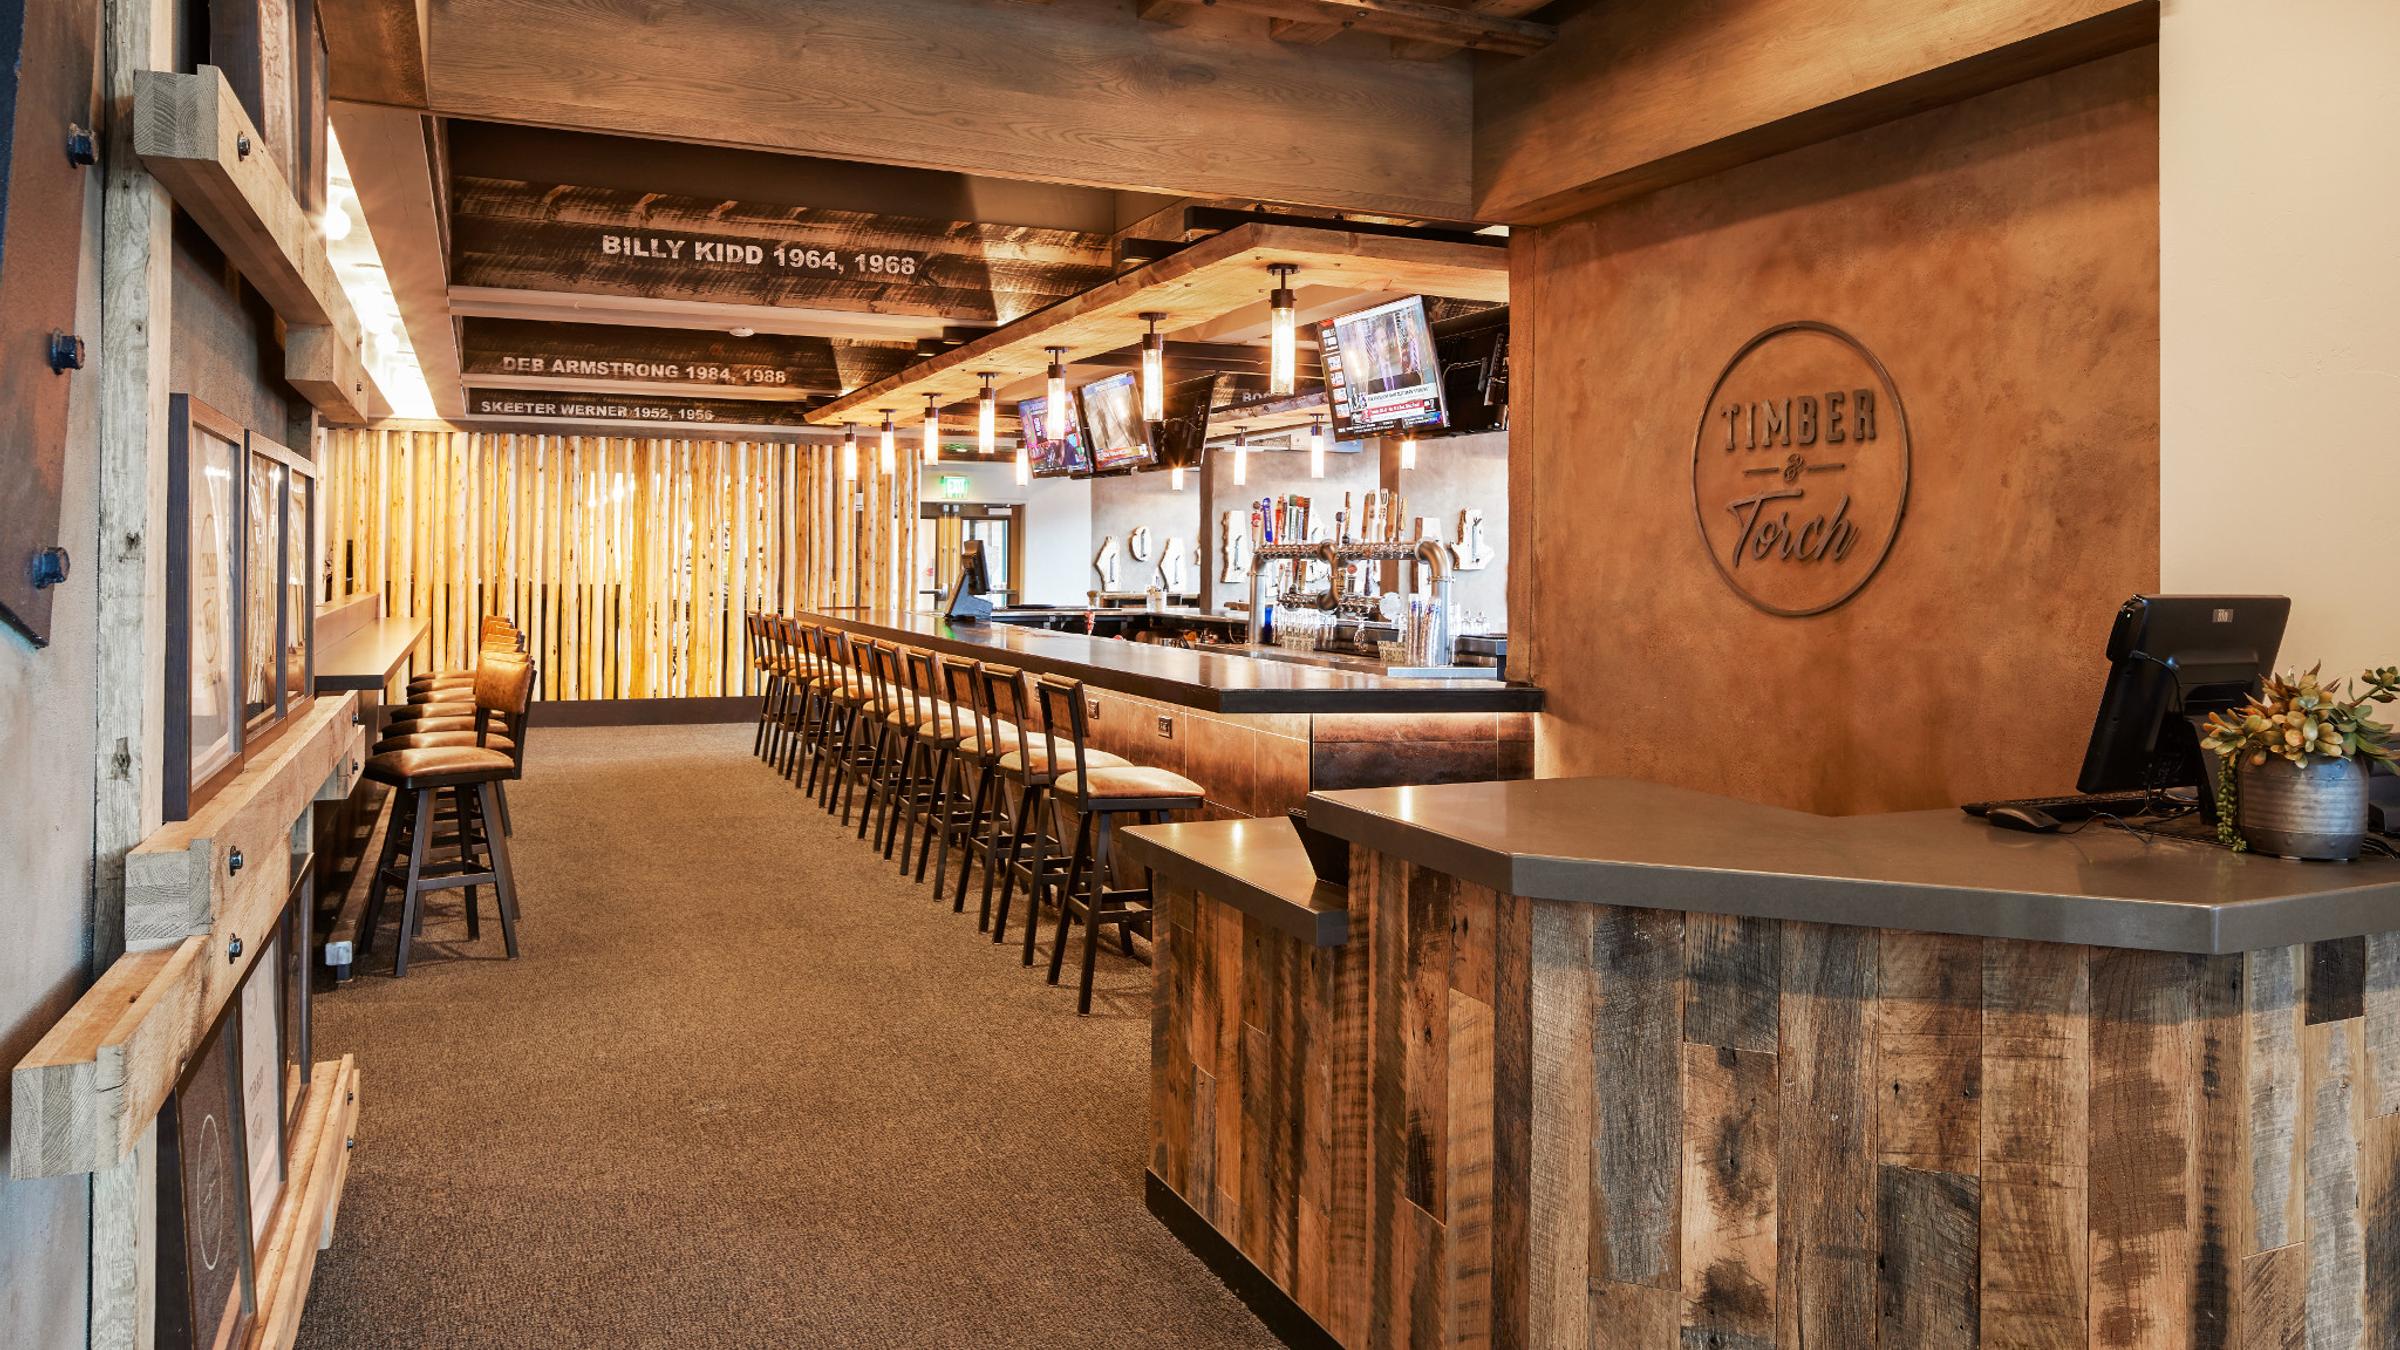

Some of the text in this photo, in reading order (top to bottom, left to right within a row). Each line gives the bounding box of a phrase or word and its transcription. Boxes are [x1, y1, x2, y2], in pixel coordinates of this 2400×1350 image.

[602, 234, 916, 275] BILLY KIDD 1964, 1968
[502, 356, 786, 384] DEB ARMSTRONG 1984, 1988
[481, 401, 715, 421] SKEETER WERNER 1952, 1956
[1721, 389, 1876, 450] TIMBER
[1783, 453, 1805, 482] &
[1727, 489, 1859, 567] Torch
